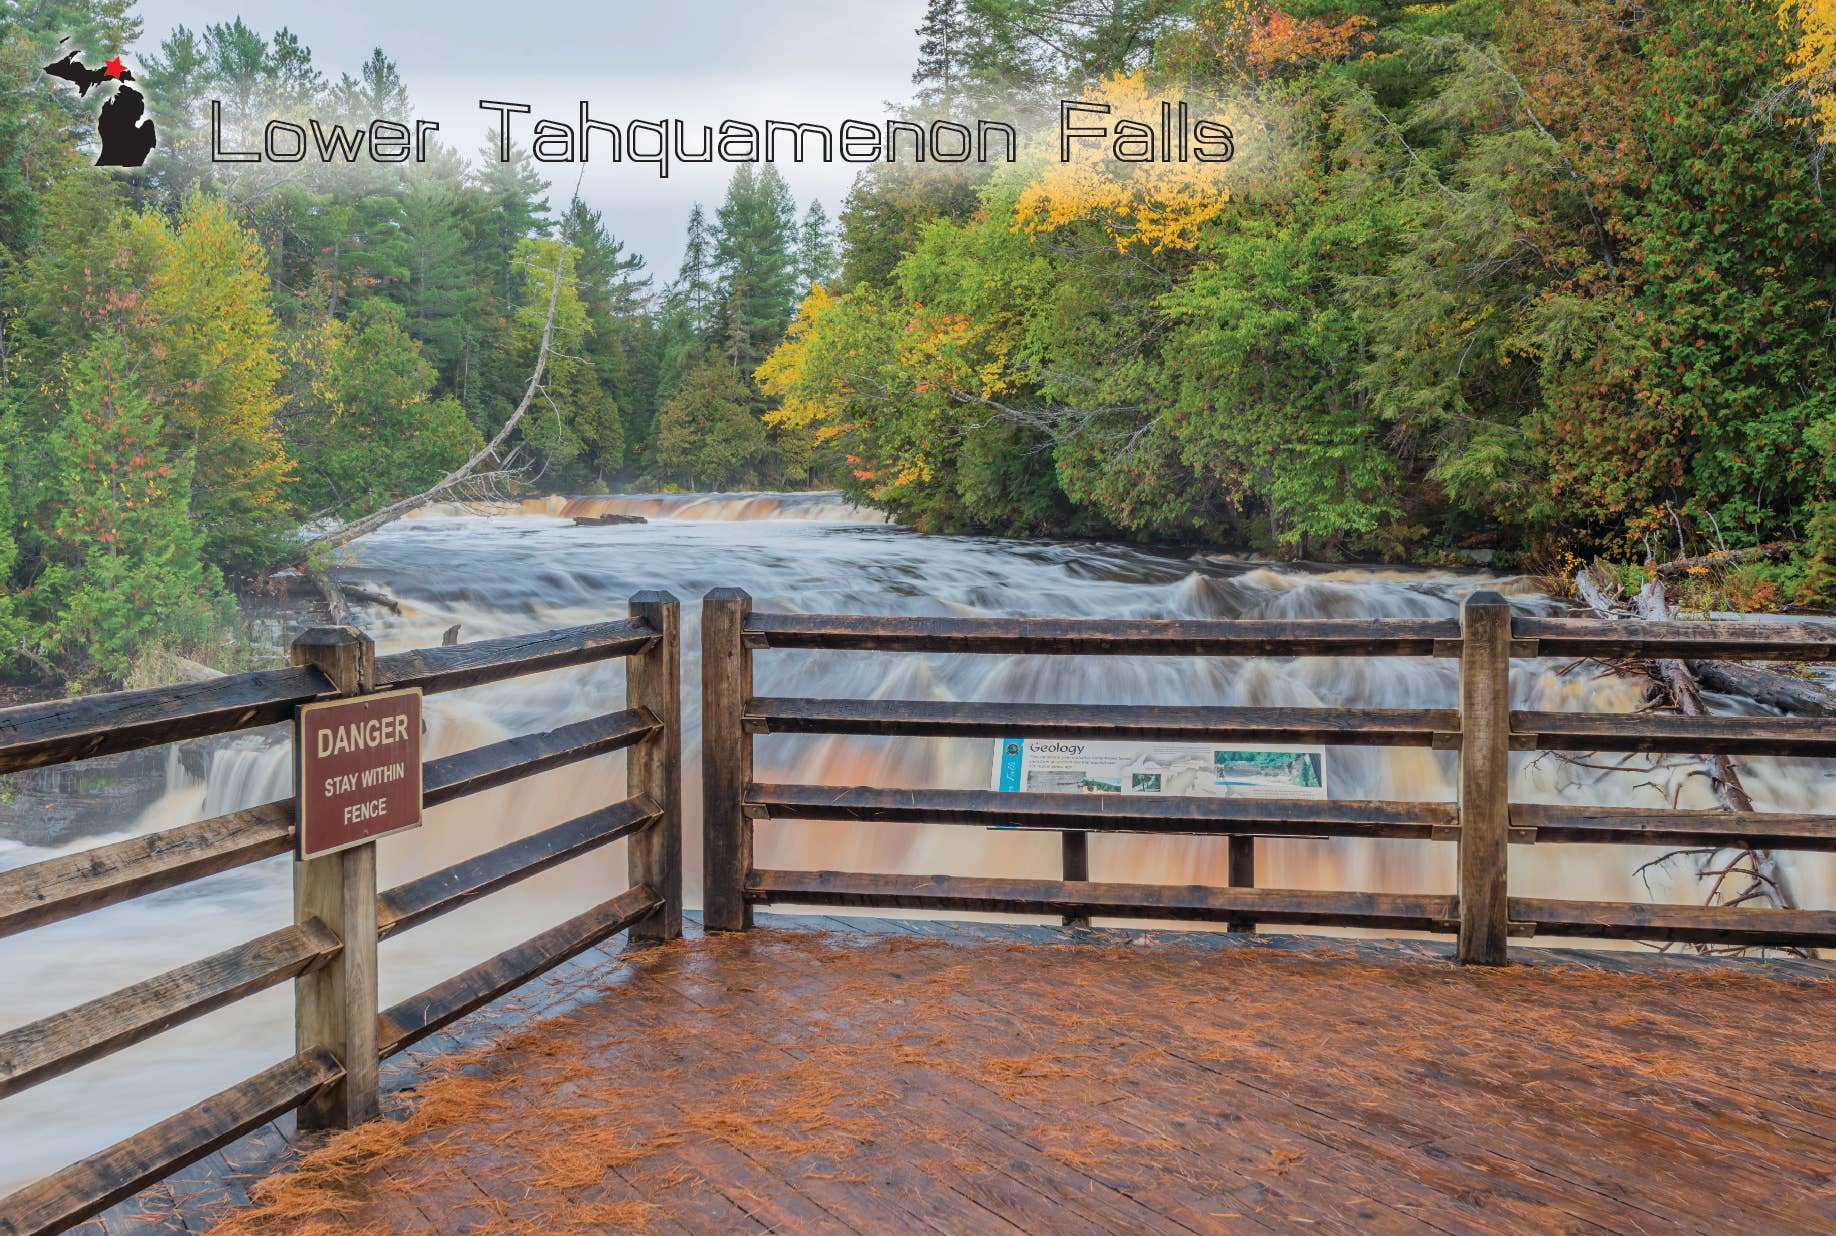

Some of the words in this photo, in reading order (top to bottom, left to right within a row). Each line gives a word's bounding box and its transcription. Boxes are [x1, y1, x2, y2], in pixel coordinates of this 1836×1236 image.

[318, 714, 409, 758] DANGER
[1030, 742, 1085, 755] Geology
[324, 772, 359, 797] STAY
[361, 762, 405, 788] WITHIN
[344, 797, 387, 825] FENCE
